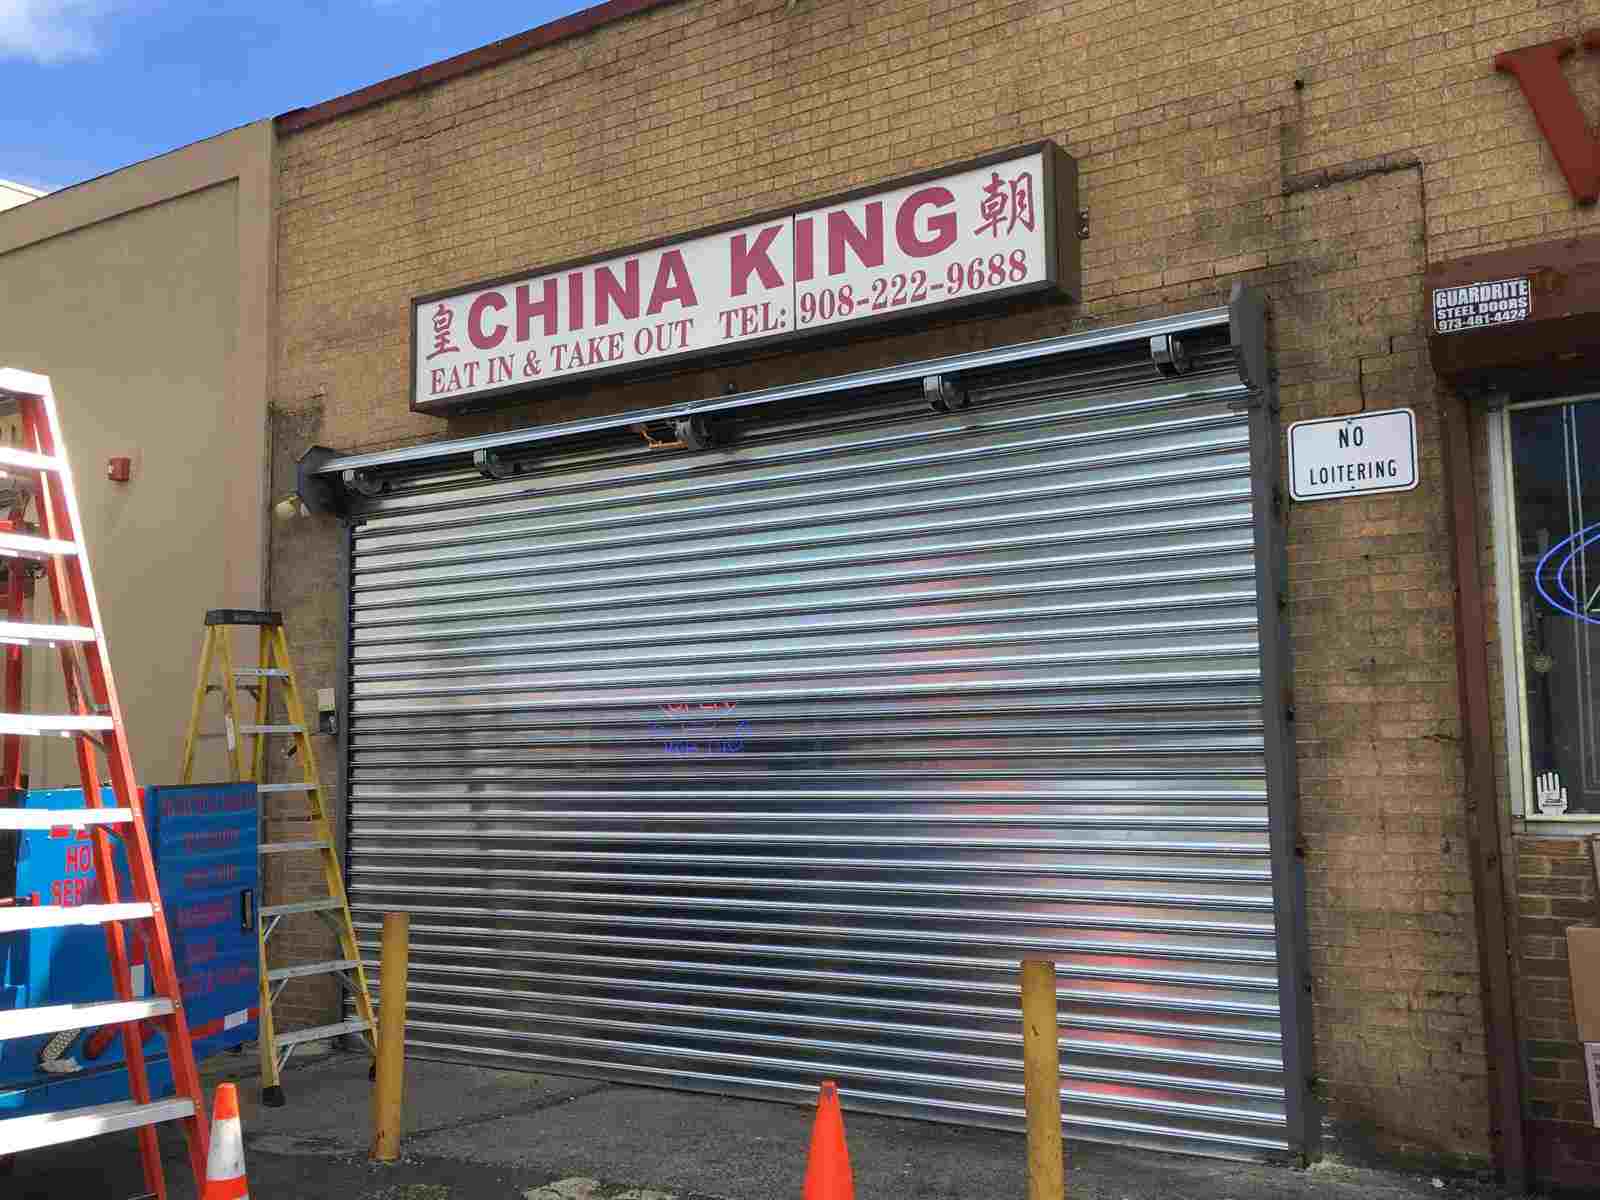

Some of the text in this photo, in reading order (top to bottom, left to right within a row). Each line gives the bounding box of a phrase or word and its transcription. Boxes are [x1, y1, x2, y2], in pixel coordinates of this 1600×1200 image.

[974, 171, 1035, 239] 朝
[467, 186, 958, 350] CHINA KING
[1435, 280, 1528, 309] GUARDRITE
[1437, 296, 1528, 320] STEEL DOORS
[426, 303, 461, 360] 皇
[430, 248, 1028, 395] EAT IN & TAKE OUT TEL: 908-222-9688
[1338, 425, 1364, 449] NO
[1309, 458, 1397, 486] LOITERING
